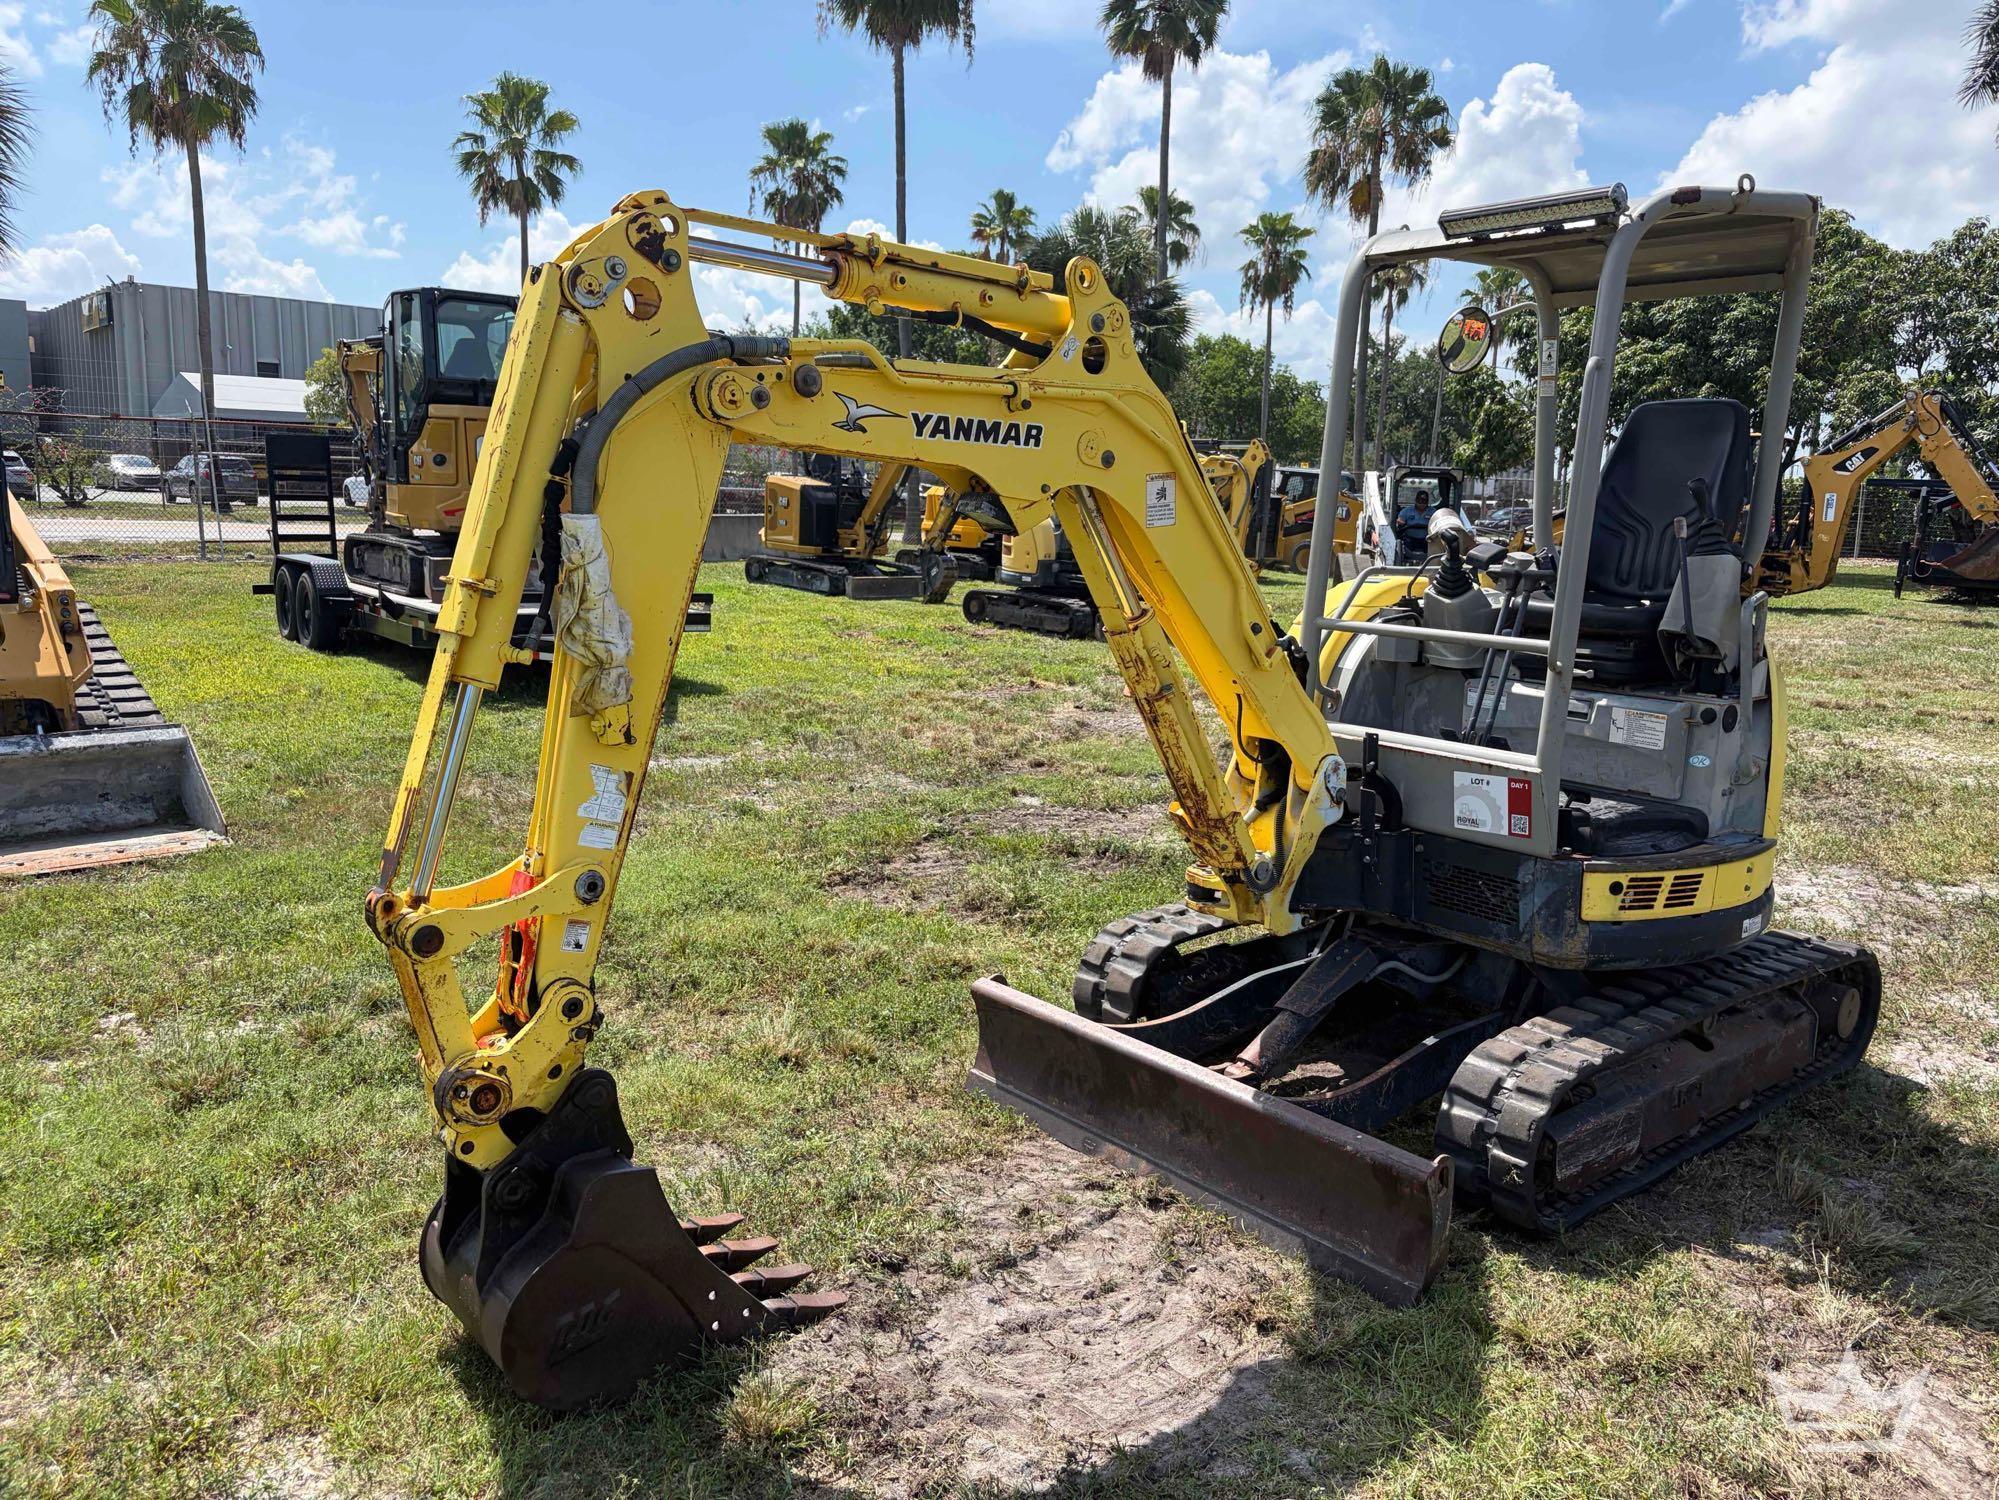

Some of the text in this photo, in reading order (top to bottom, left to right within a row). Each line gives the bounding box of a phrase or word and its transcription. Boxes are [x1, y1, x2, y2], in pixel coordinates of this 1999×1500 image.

[910, 412, 1043, 448] YANMAR
[1845, 452, 1865, 471] CAT
[1336, 507, 1348, 519] AT
[1691, 756, 1707, 766] OK
[1457, 816, 1479, 825] ROYAL
